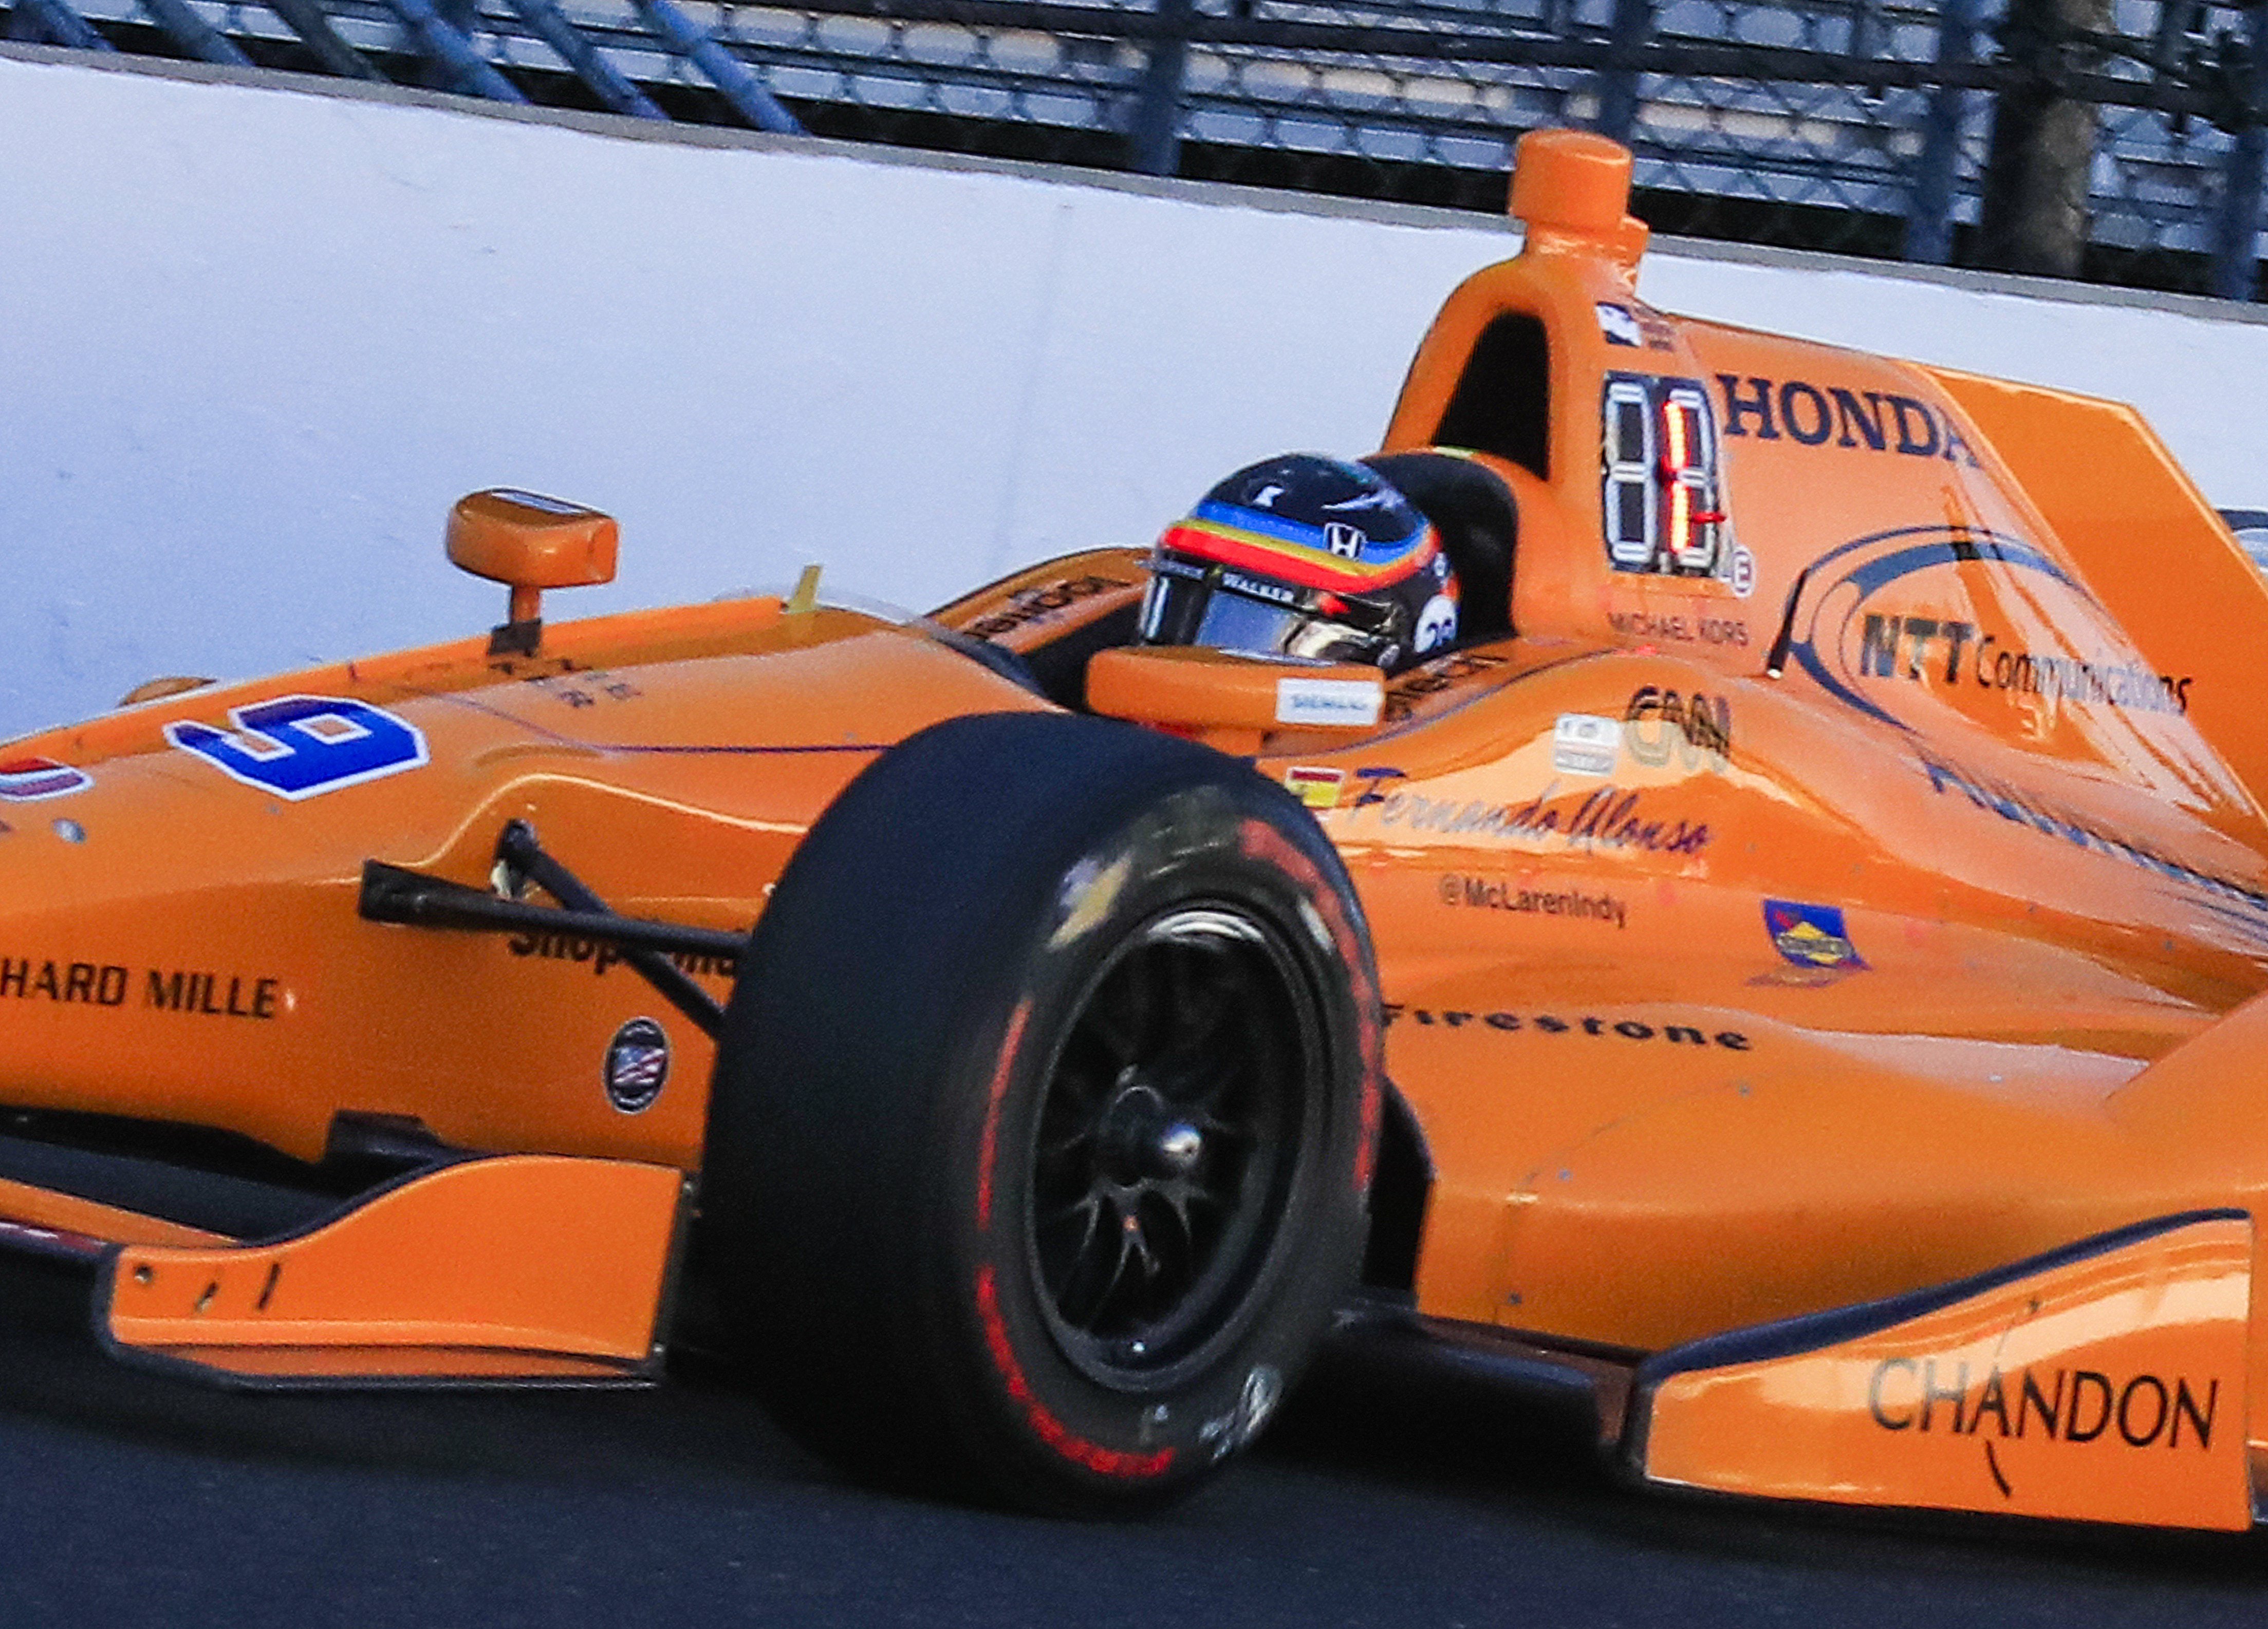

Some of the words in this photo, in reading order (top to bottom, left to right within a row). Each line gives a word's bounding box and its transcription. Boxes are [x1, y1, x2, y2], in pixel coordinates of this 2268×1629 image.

[1859, 613, 1975, 685] NTT
[1349, 767, 1559, 842] Fernando
[1565, 783, 1711, 855] Alonso
[1, 957, 129, 1007] HARD
[147, 968, 280, 1019] MILLE
[1381, 1004, 1751, 1052] Firestone
[1868, 1356, 2219, 1450] CHANDON
